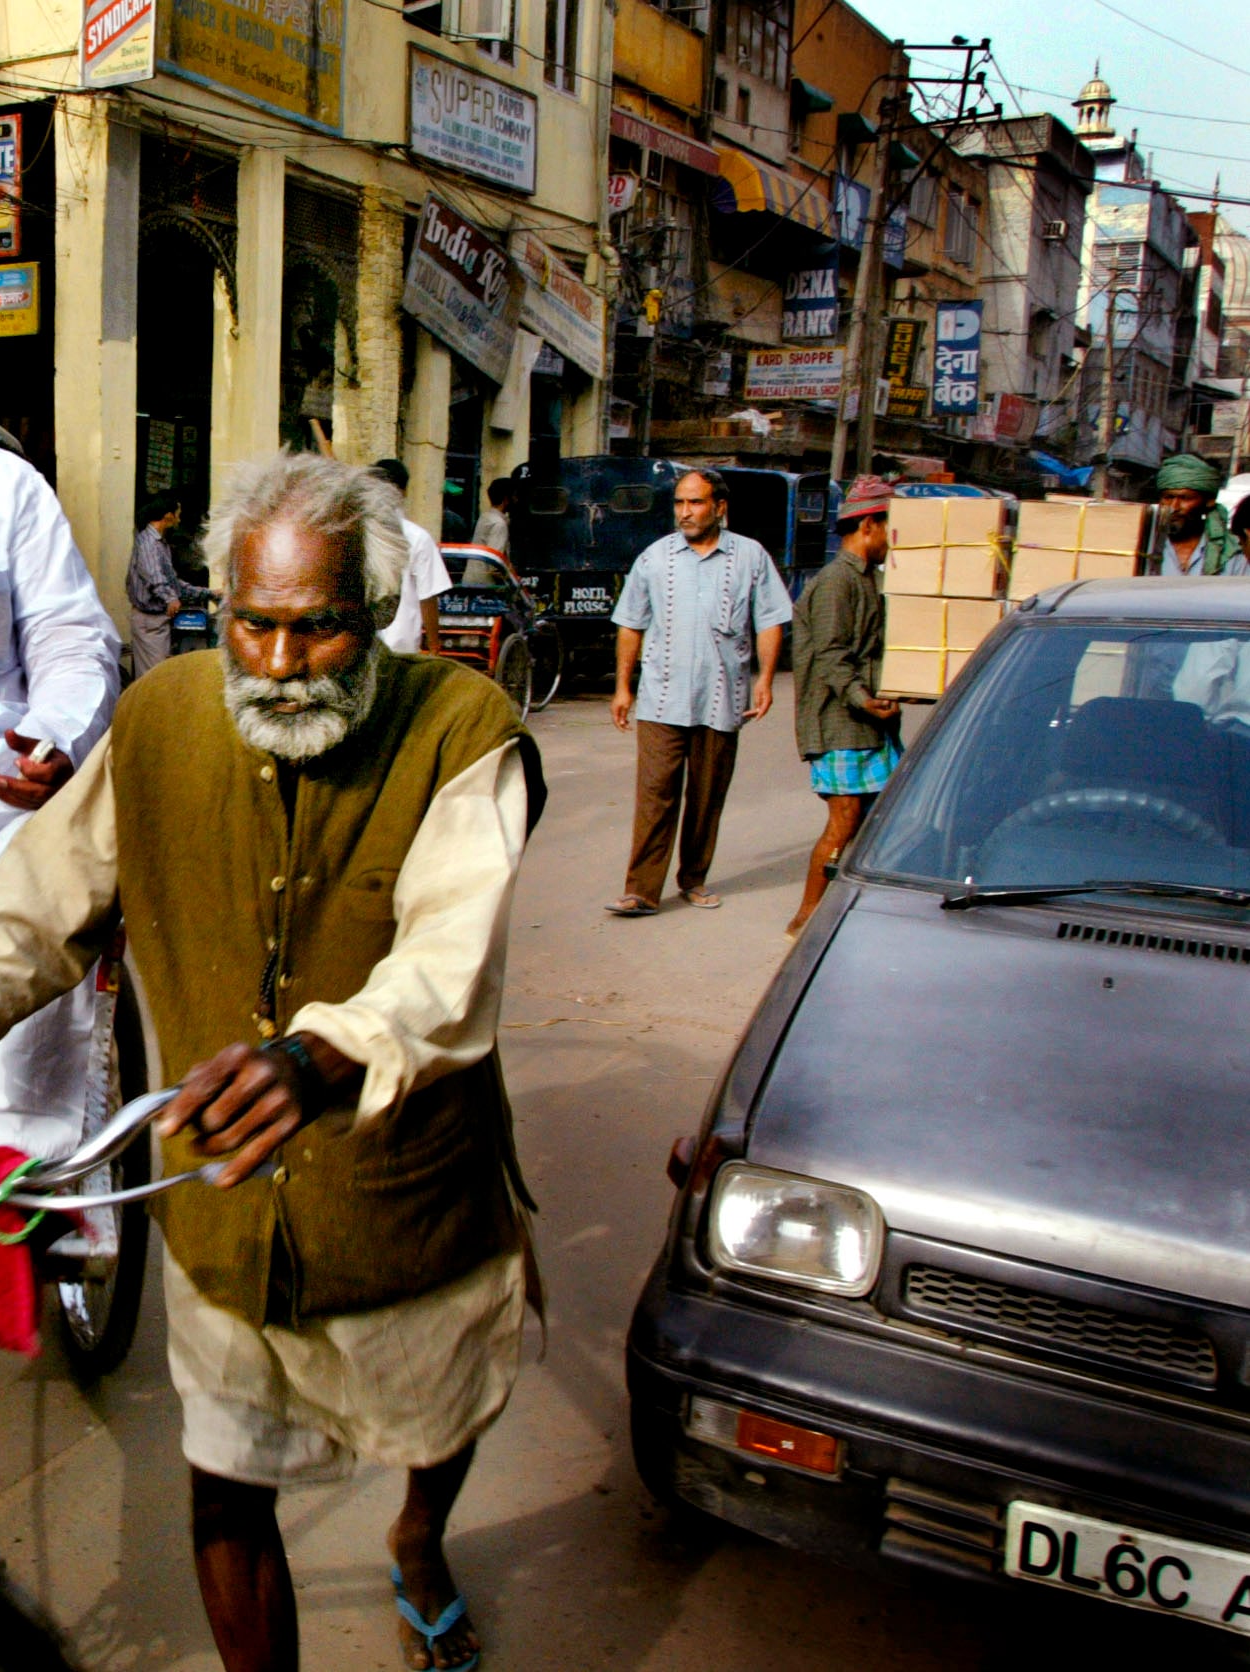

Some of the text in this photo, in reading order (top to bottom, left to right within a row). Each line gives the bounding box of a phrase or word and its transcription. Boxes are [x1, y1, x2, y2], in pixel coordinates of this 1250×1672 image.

[431, 68, 496, 129] SUPER
[498, 93, 525, 120] PAPER
[494, 115, 532, 144] COMPANY
[425, 203, 479, 275] India
[785, 268, 836, 300] DENA
[783, 308, 835, 338] BANK
[756, 351, 834, 367] KARD SHOPPE
[935, 346, 979, 375] देना
[934, 376, 977, 407] बैंक
[1019, 1520, 1192, 1610] DL6C
